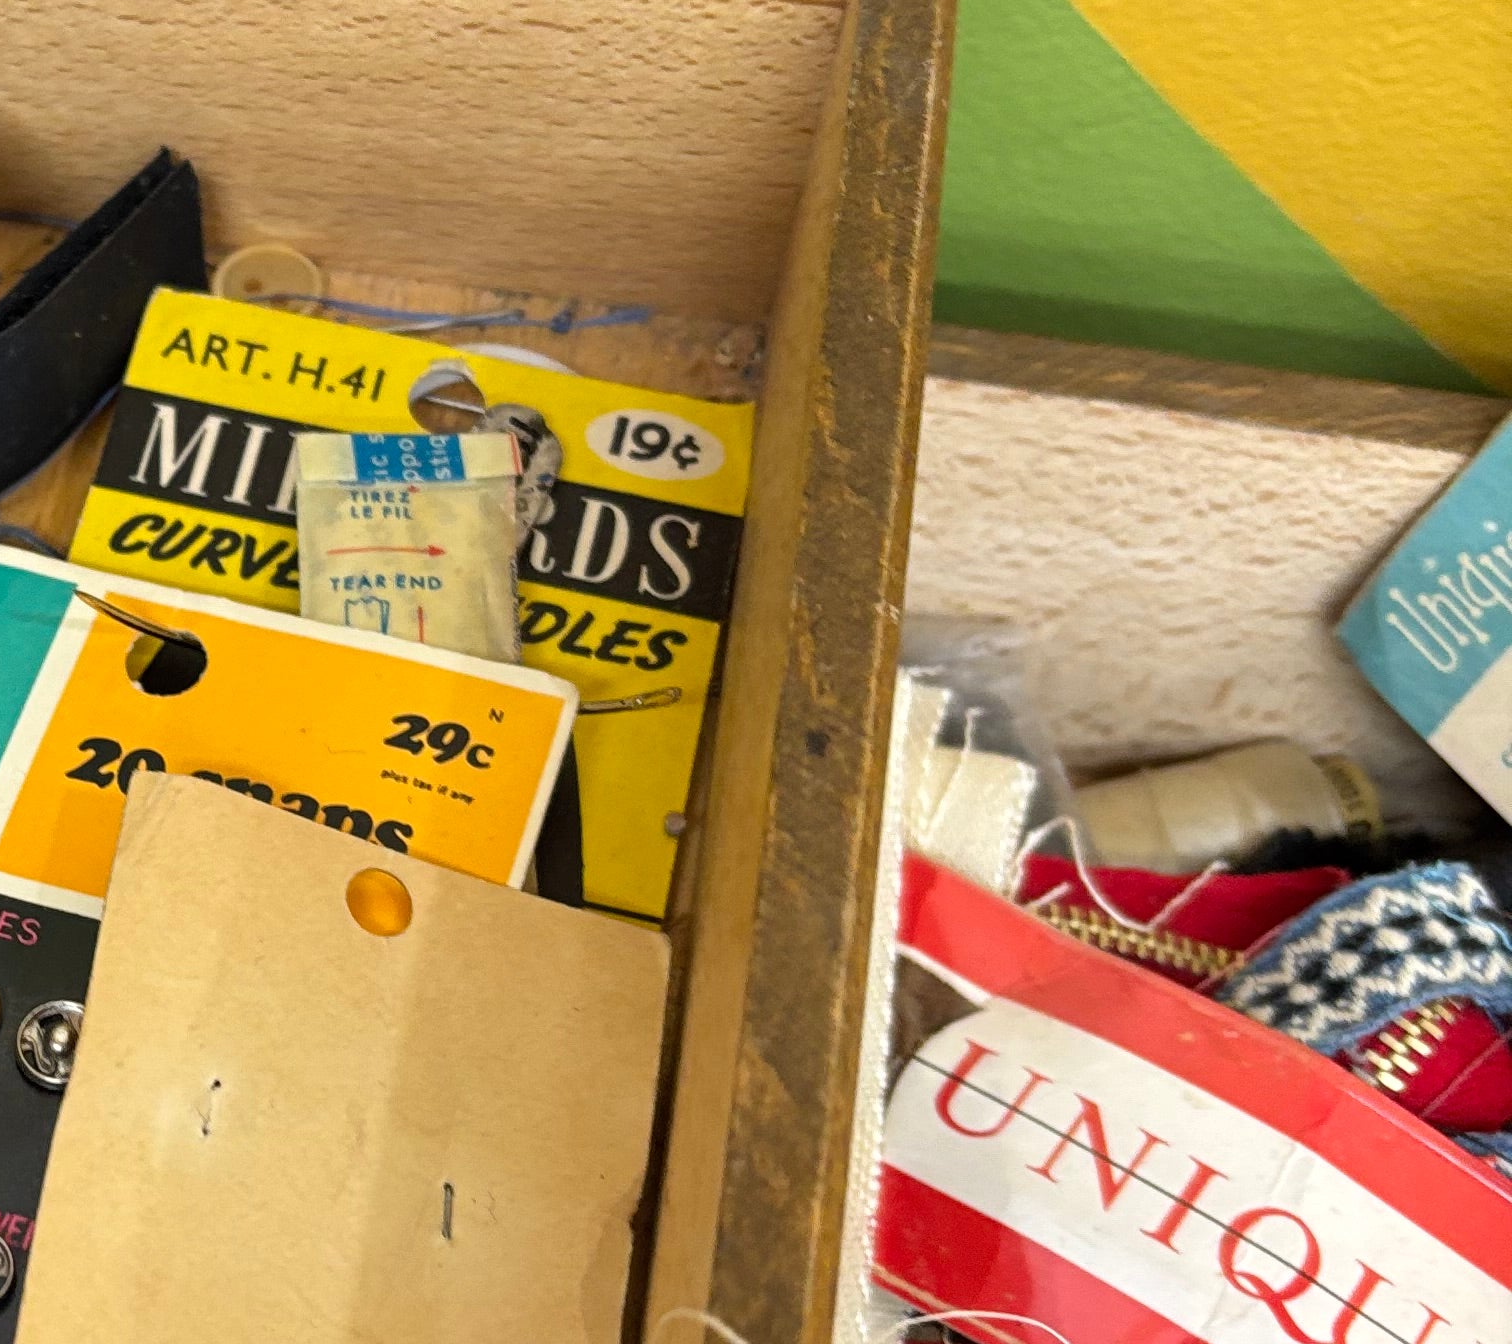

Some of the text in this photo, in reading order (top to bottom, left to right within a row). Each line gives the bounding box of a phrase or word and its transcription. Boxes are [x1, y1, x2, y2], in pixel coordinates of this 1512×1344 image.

[162, 327, 386, 404] ART. H.41
[608, 415, 704, 471] 19¢
[329, 574, 444, 592] TEAR END
[521, 594, 688, 672] DLES
